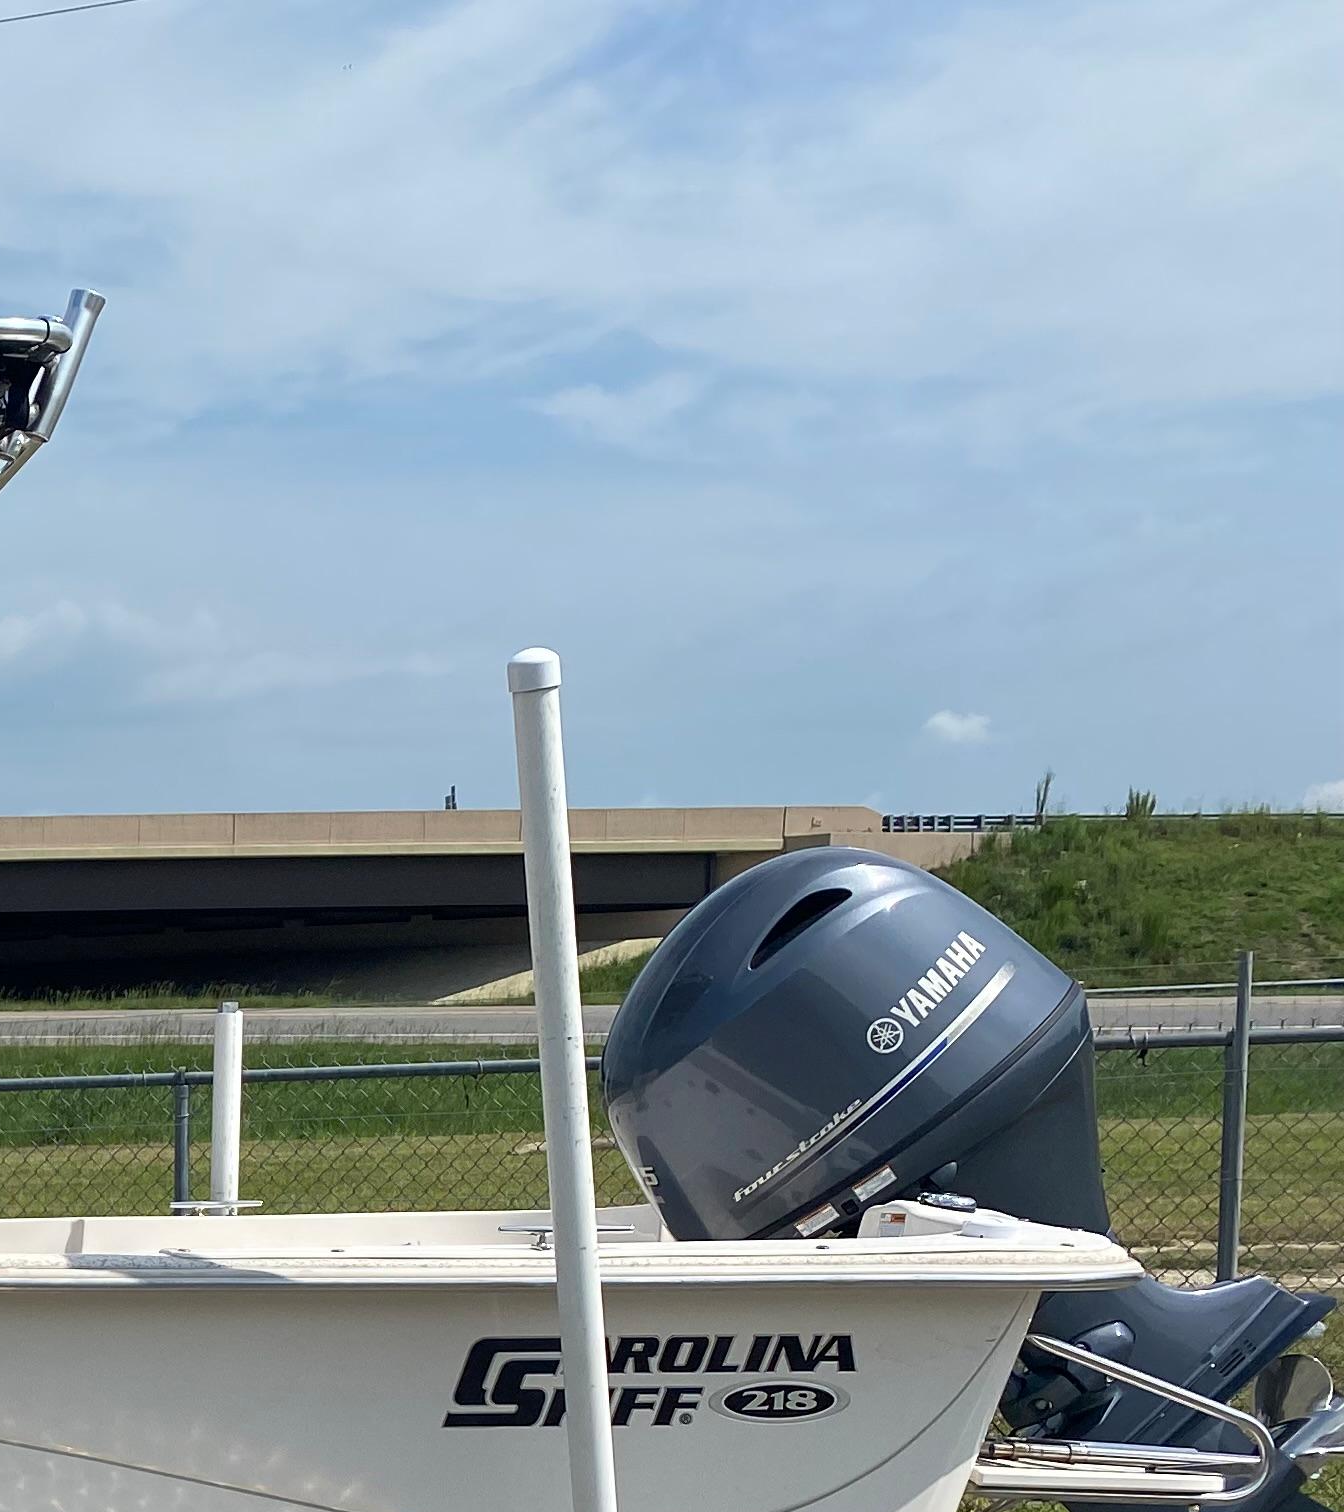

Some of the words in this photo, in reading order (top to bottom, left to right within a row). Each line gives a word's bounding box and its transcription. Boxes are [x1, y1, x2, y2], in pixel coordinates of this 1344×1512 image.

[890, 930, 986, 1028] YAMAHA
[453, 1335, 857, 1405] CROLINA
[740, 1389, 818, 1411] 218
